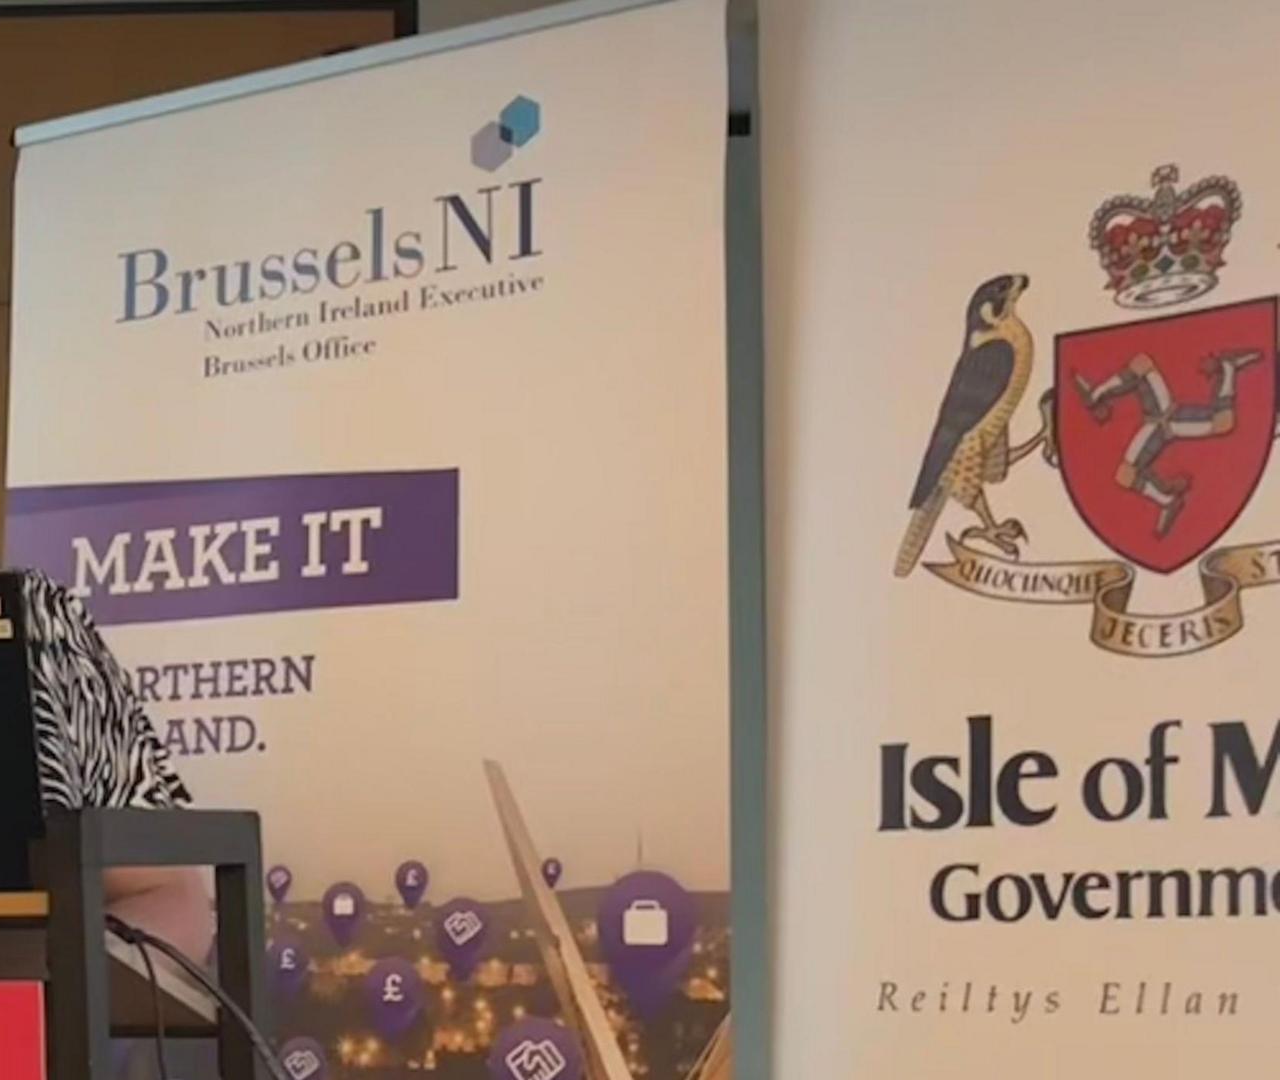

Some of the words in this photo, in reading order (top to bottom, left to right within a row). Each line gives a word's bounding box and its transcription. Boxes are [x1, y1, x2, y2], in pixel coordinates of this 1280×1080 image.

[204, 310, 309, 341] Northern
[319, 289, 410, 325] Ireland
[420, 274, 544, 309] Executive
[203, 345, 295, 378] Brussels
[303, 335, 377, 360] Office
[68, 517, 280, 598] MAKE
[301, 507, 383, 577] IT
[1100, 608, 1232, 649] JECERIS
[124, 655, 315, 702] RTHERN
[162, 715, 266, 755] AND.
[877, 715, 1059, 831] Isle
[1081, 719, 1183, 822] of
[929, 863, 1280, 922] Governm
[877, 980, 1062, 1025] Reiltys
[1098, 980, 1240, 1015] Ellan
